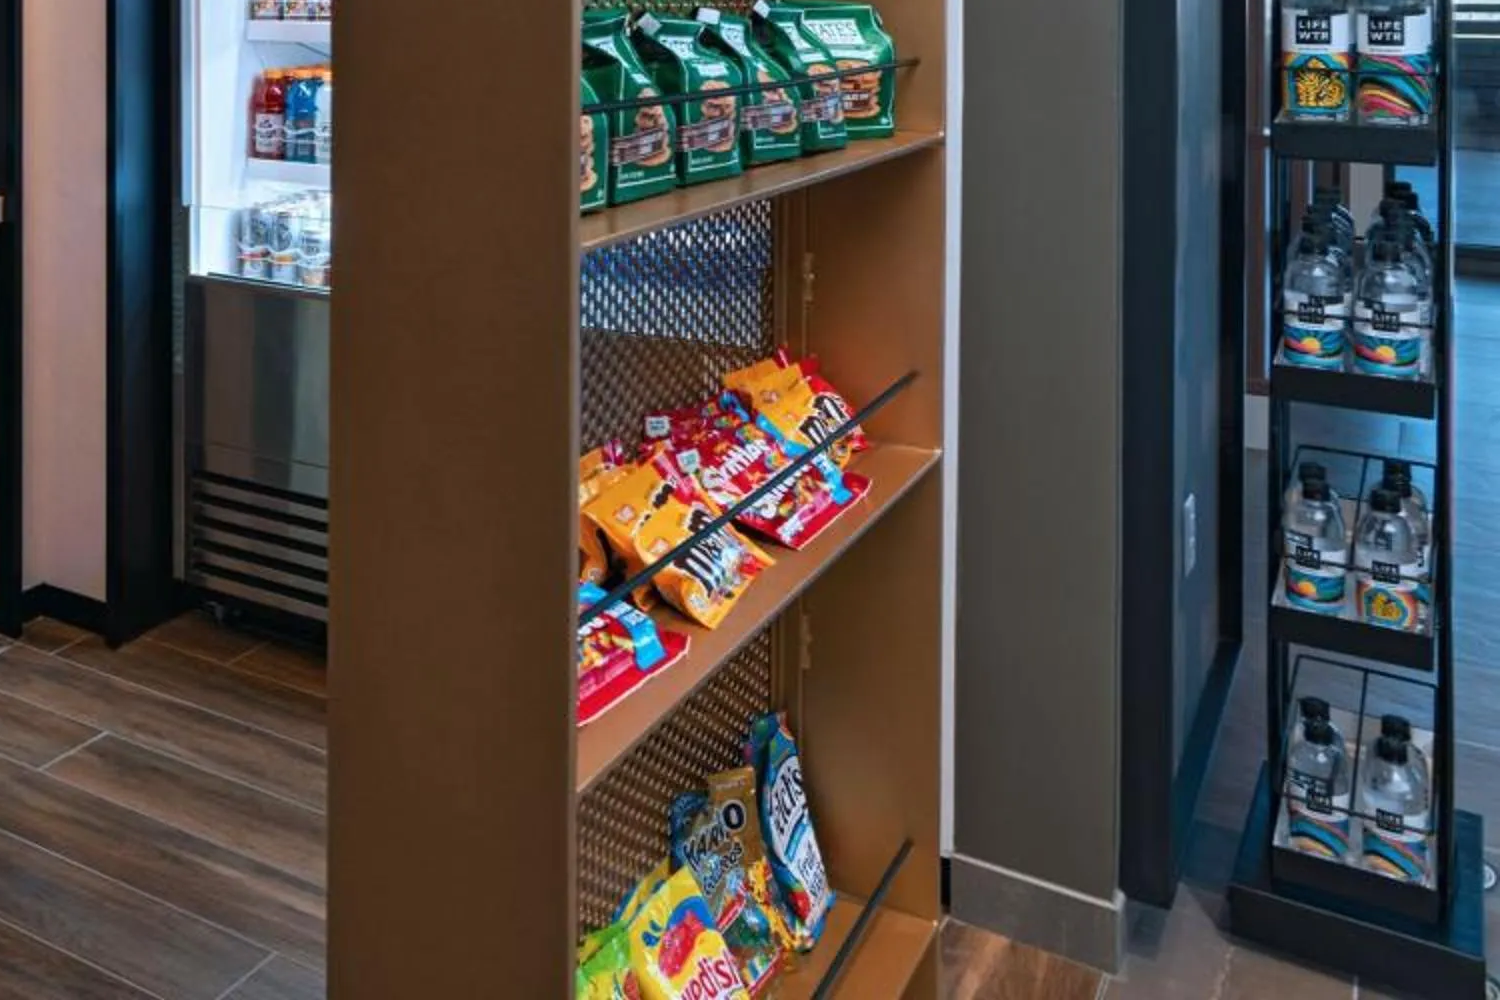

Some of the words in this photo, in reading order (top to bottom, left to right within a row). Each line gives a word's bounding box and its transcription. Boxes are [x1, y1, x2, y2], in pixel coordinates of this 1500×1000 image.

[1299, 20, 1329, 29] LIFE
[1370, 21, 1402, 30] LIFE
[1299, 31, 1329, 40] WTR
[1370, 32, 1402, 41] WTR
